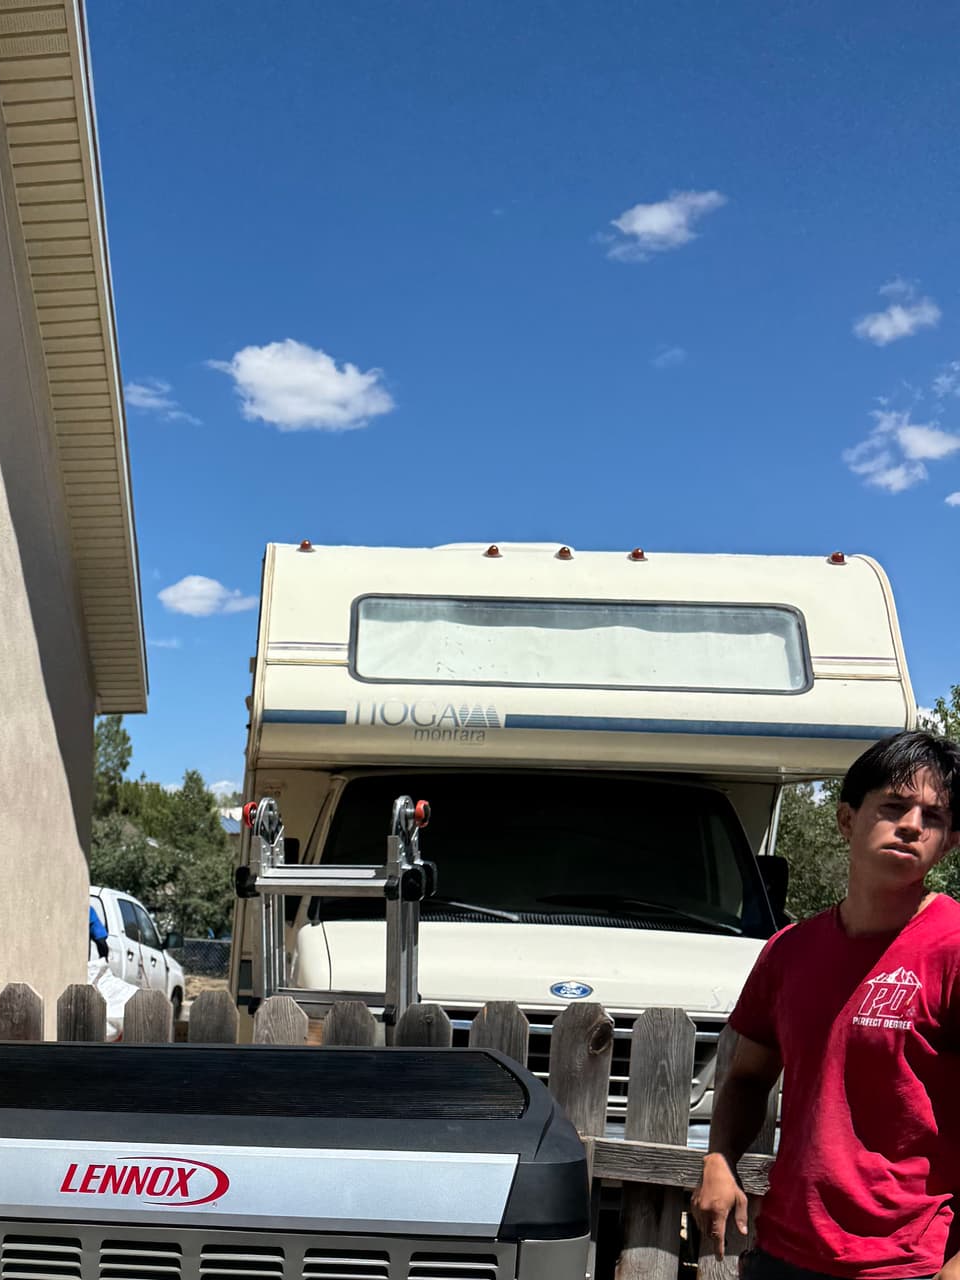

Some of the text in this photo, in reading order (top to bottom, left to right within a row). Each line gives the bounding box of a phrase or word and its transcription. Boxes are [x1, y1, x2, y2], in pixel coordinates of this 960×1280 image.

[852, 1016, 912, 1030] PERFECT DEGREE
[60, 1163, 197, 1197] LENNOX
